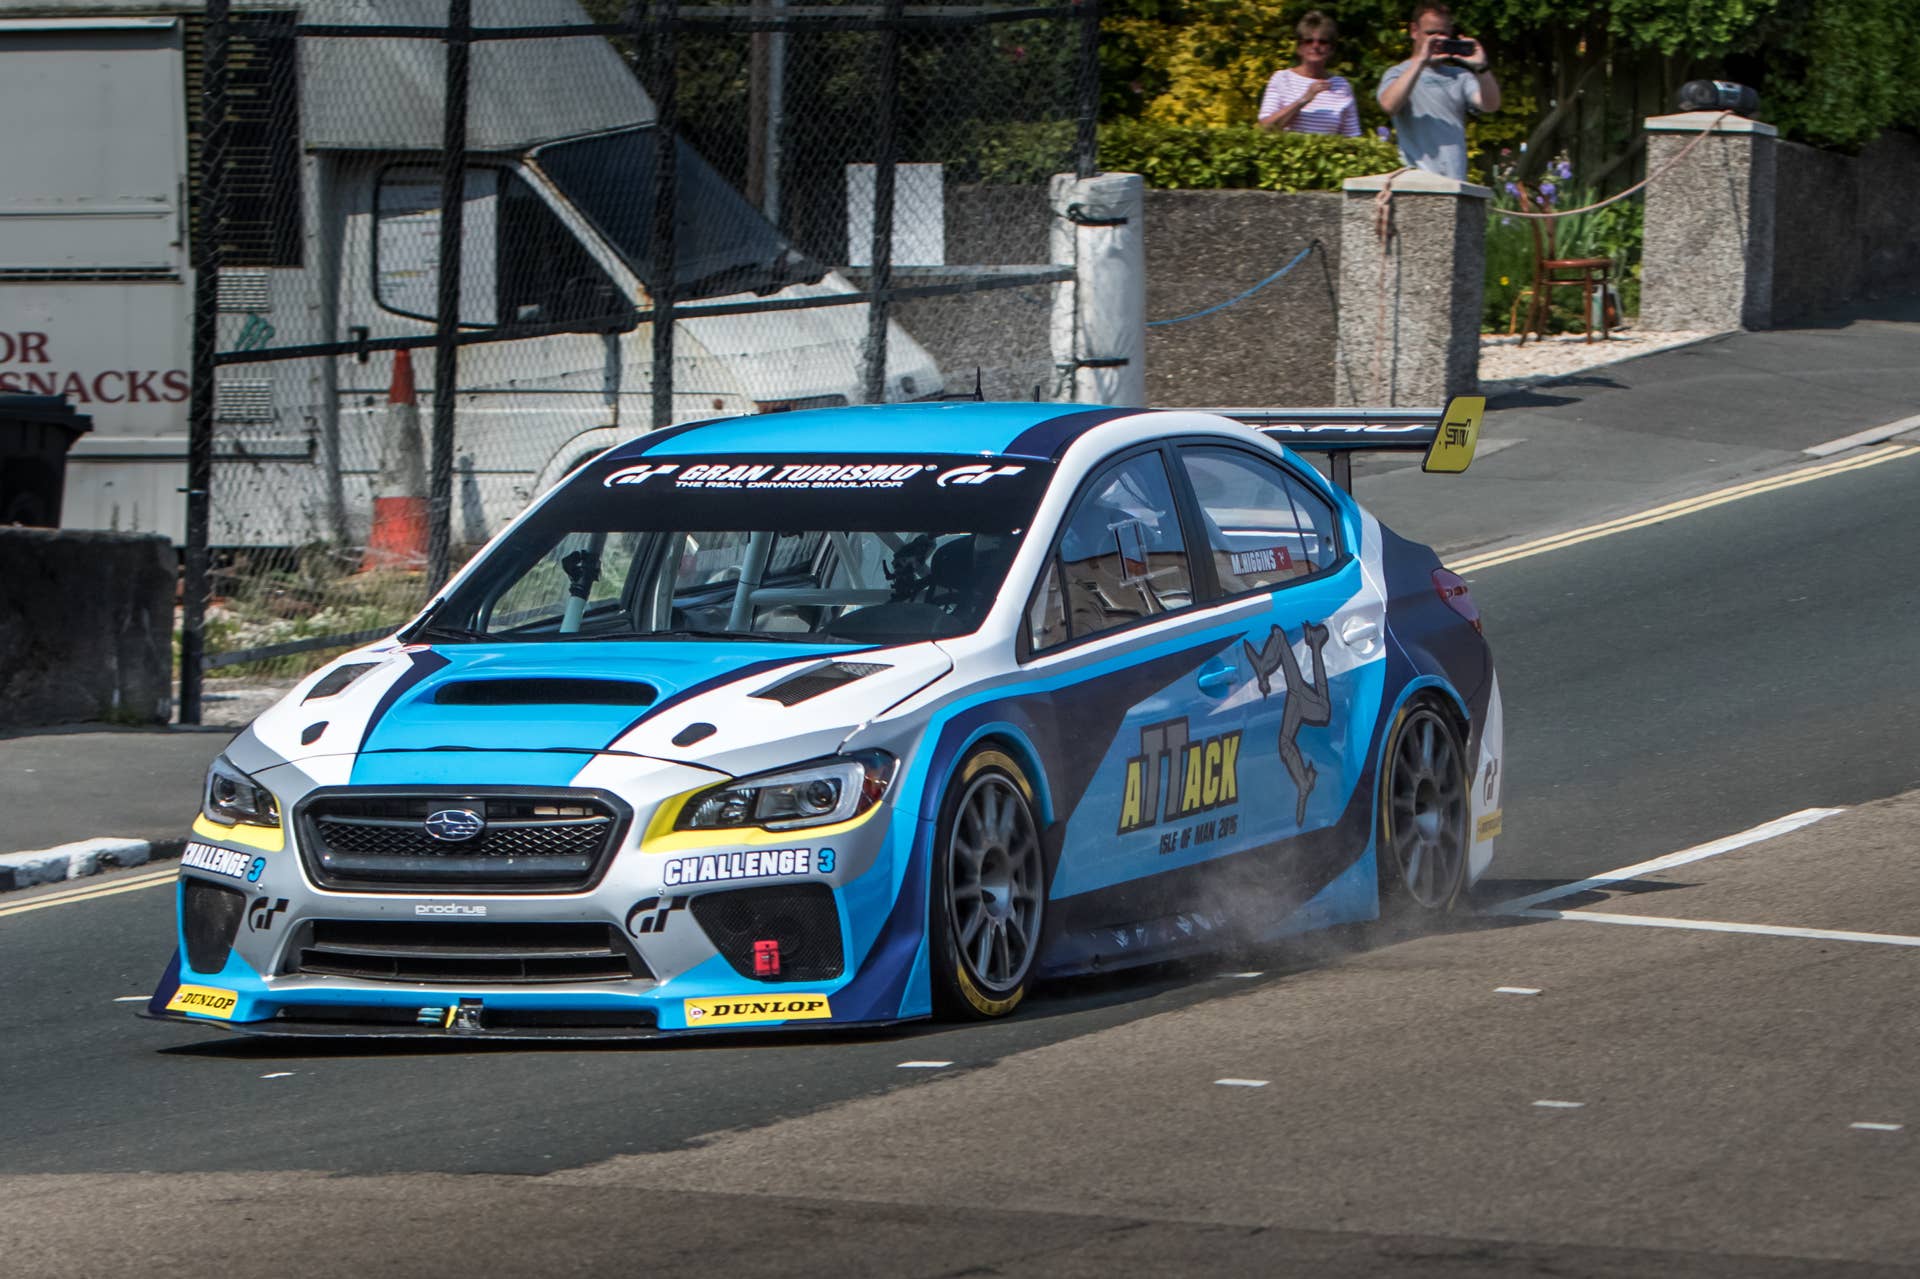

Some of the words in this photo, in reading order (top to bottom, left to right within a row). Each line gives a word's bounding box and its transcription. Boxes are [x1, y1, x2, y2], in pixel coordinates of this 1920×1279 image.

[0, 370, 191, 403] SNACKS
[678, 465, 774, 481] GRAN
[772, 465, 923, 481] TURISMO
[811, 481, 904, 489] SIMULATOR
[1117, 715, 1243, 836] ATTACK
[1159, 831, 1178, 855] ISLE
[1180, 826, 1192, 849] OF
[1194, 820, 1216, 845] MAN
[247, 857, 266, 883] 3
[664, 849, 811, 886] CHALLENGE
[818, 848, 836, 873] 3
[182, 993, 236, 1009] DUNLOP
[711, 1001, 824, 1017] DUNLOP
